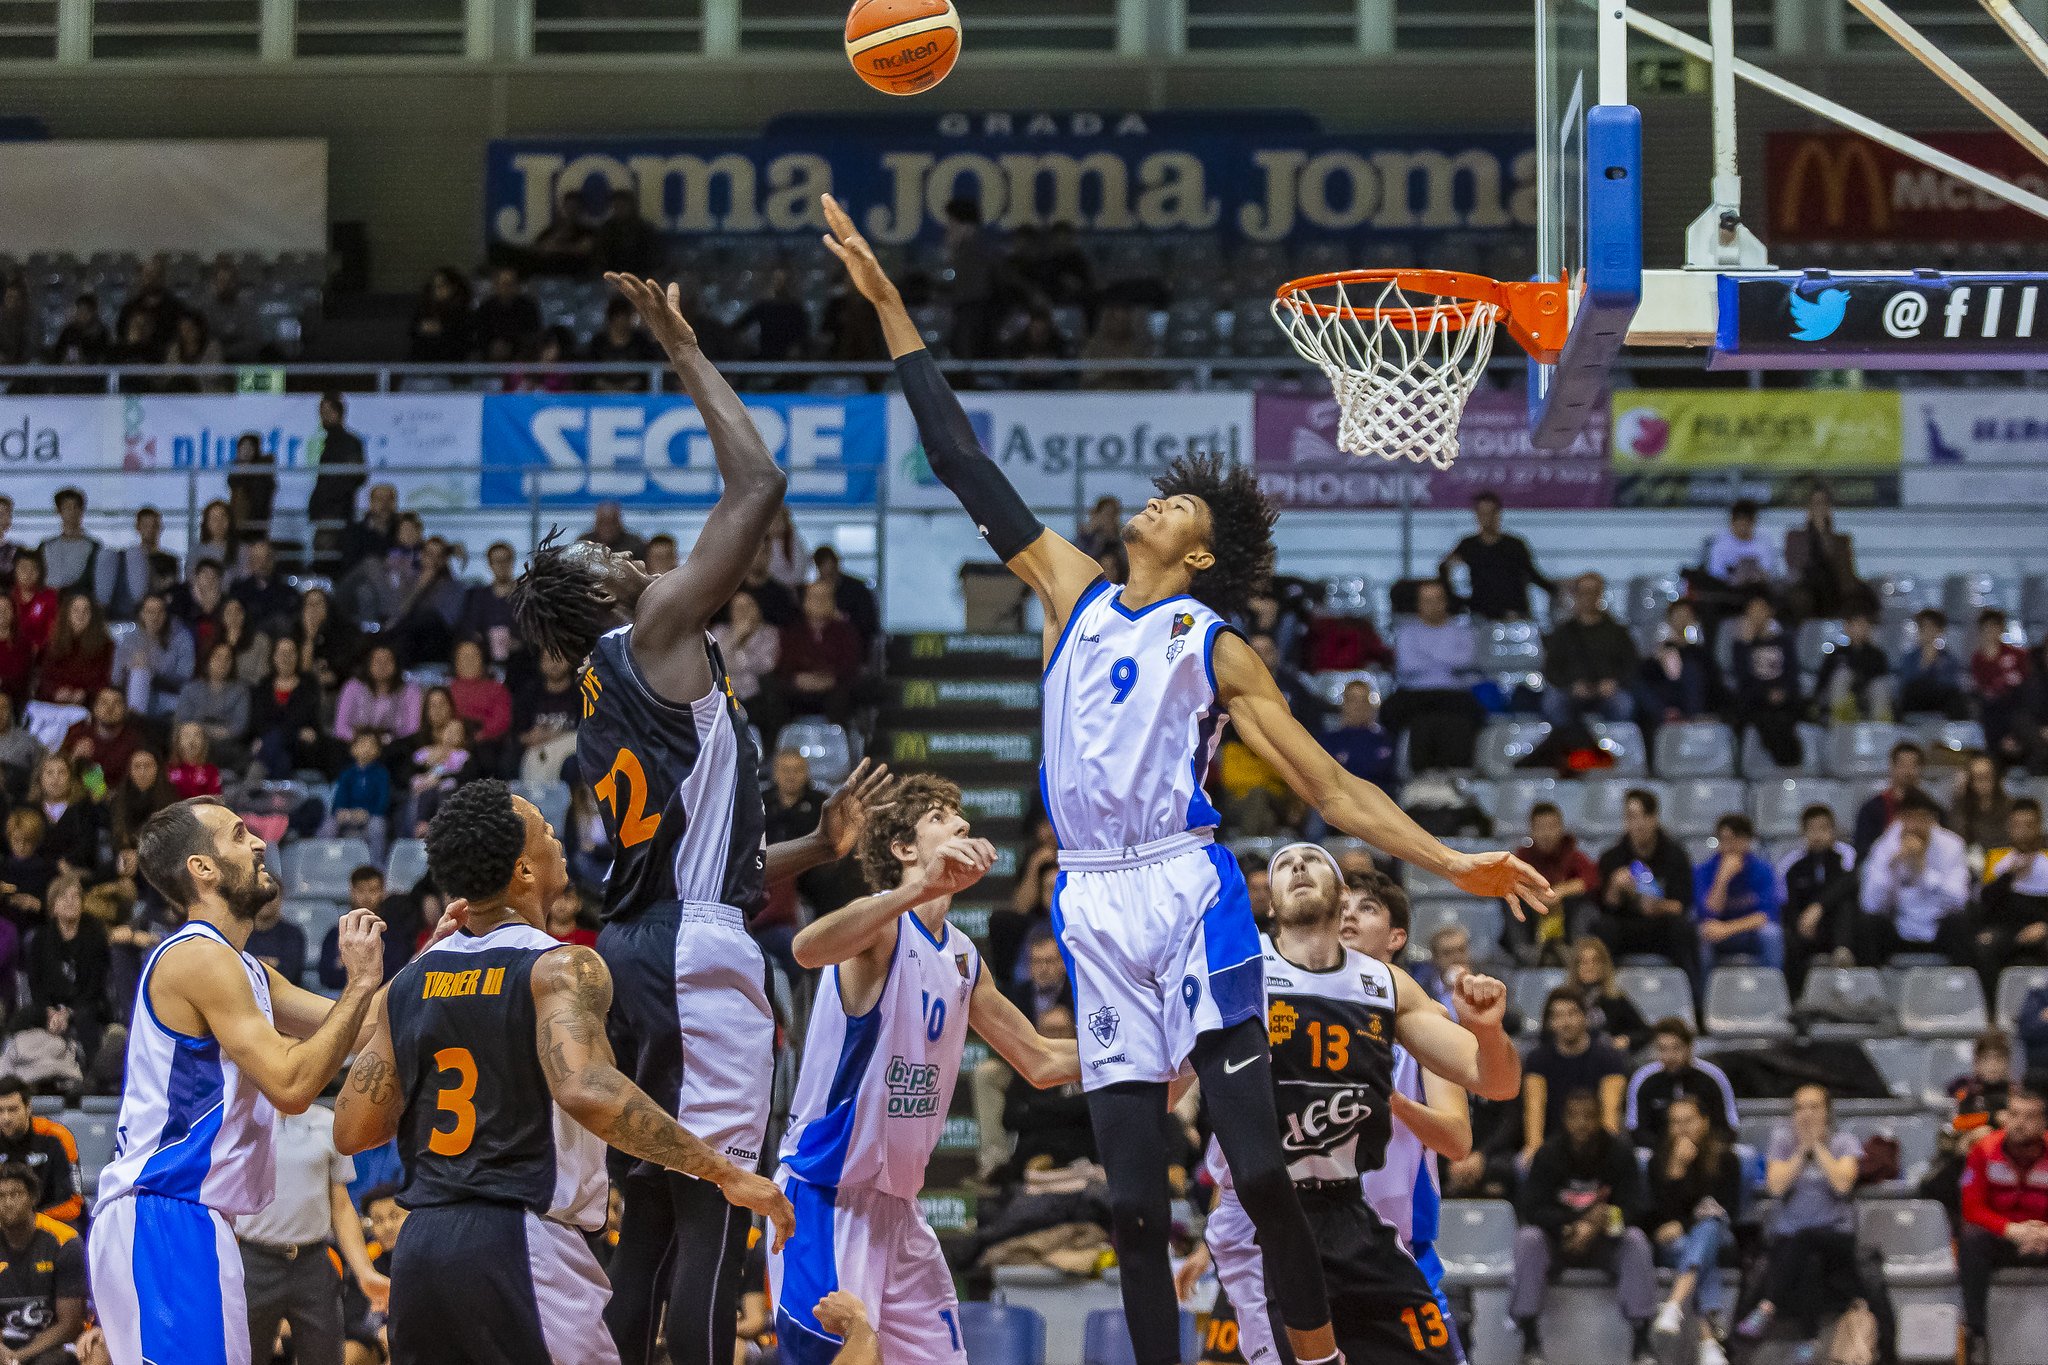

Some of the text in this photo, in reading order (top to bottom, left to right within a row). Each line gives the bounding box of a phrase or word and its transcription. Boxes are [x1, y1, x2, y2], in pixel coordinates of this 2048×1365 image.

[872, 41, 938, 70] molten
[938, 113, 1148, 137] GRADA
[1110, 656, 1139, 704] 9
[422, 967, 506, 999] TURNER III
[1092, 1053, 1126, 1070] SPALDING
[1307, 1021, 1350, 1071] 13
[429, 1047, 478, 1157] 3
[1205, 1319, 1239, 1353] 10
[1401, 1302, 1449, 1351] 13
